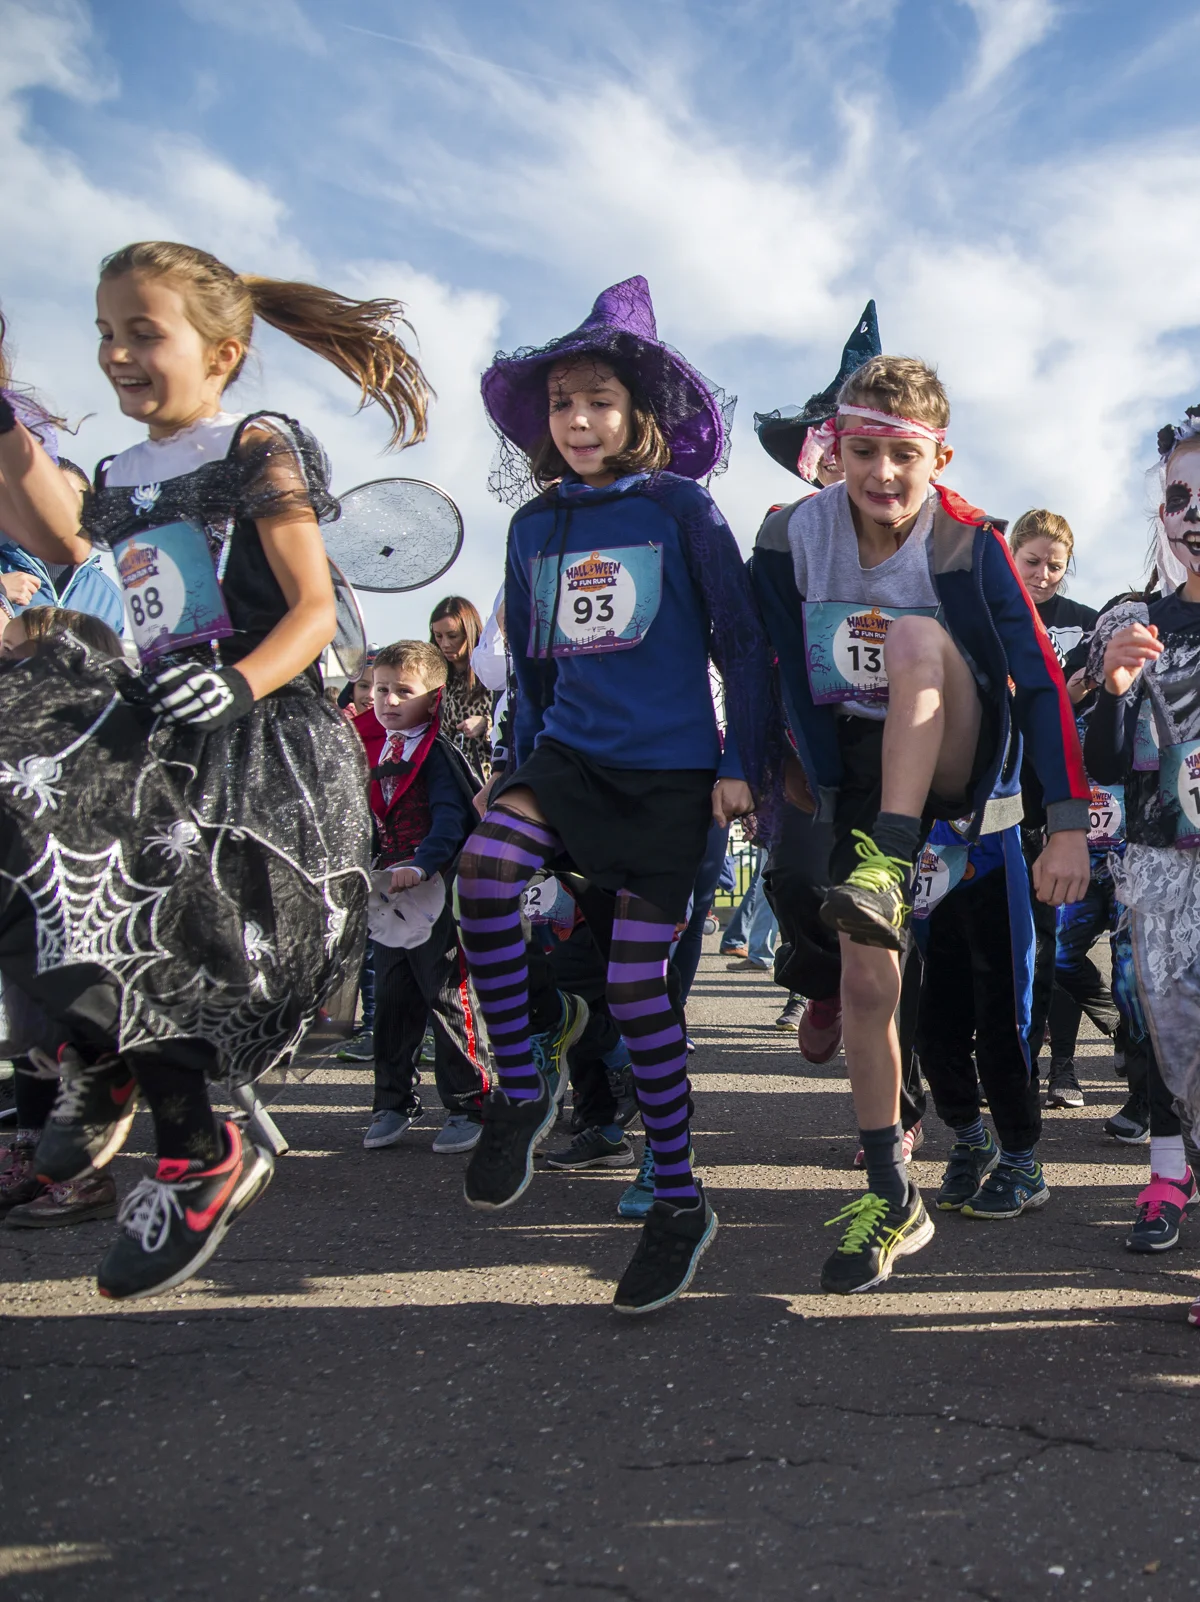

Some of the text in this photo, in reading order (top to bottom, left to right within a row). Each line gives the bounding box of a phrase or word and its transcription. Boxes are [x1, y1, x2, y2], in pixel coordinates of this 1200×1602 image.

[565, 561, 621, 579] HALLOWEEN
[130, 587, 163, 626] 88
[573, 594, 614, 624] 93
[846, 615, 893, 631] HALLOWE
[847, 645, 887, 673] 13
[1089, 811, 1113, 828] 07
